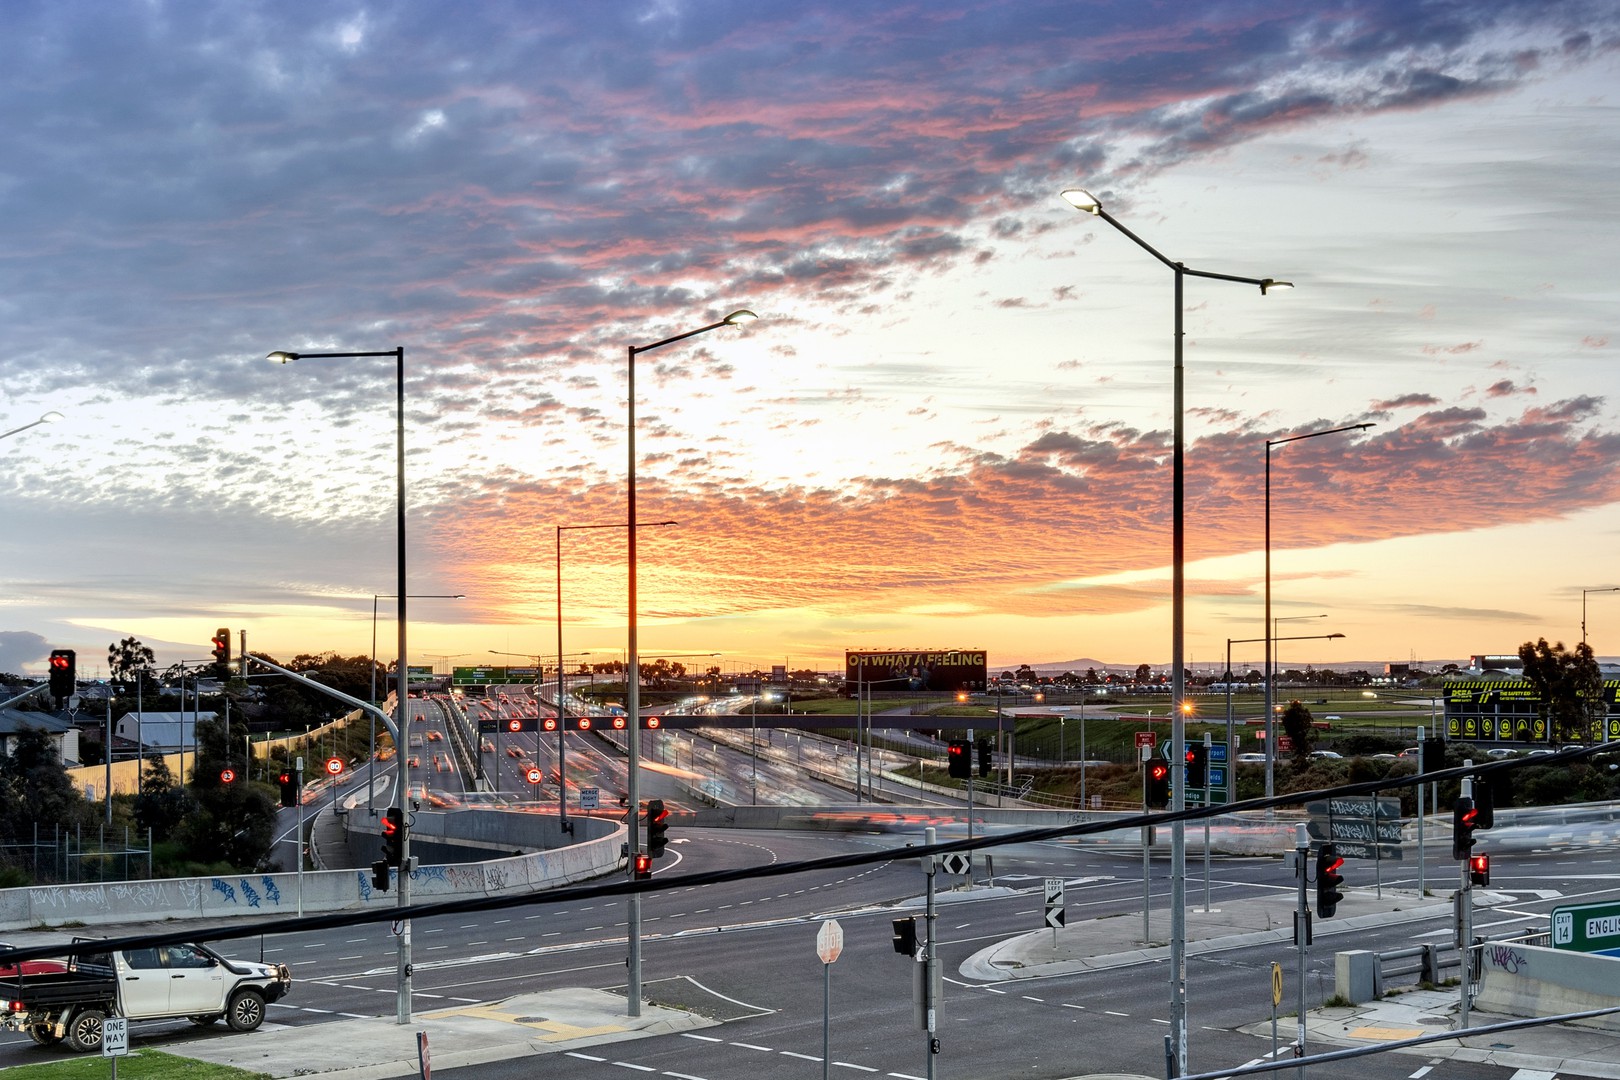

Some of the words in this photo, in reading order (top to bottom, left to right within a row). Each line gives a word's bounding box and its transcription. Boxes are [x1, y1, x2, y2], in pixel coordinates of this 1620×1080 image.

[849, 655, 869, 666] OH
[872, 655, 912, 666] WHAT
[927, 654, 984, 666] FEELING
[330, 762, 339, 770] 80
[530, 772, 538, 780] 80
[1556, 915, 1571, 924] EXIT
[1558, 926, 1569, 941] 14
[819, 932, 841, 951] STOP
[106, 1021, 124, 1032] ONE
[105, 1032, 125, 1043] WAY
